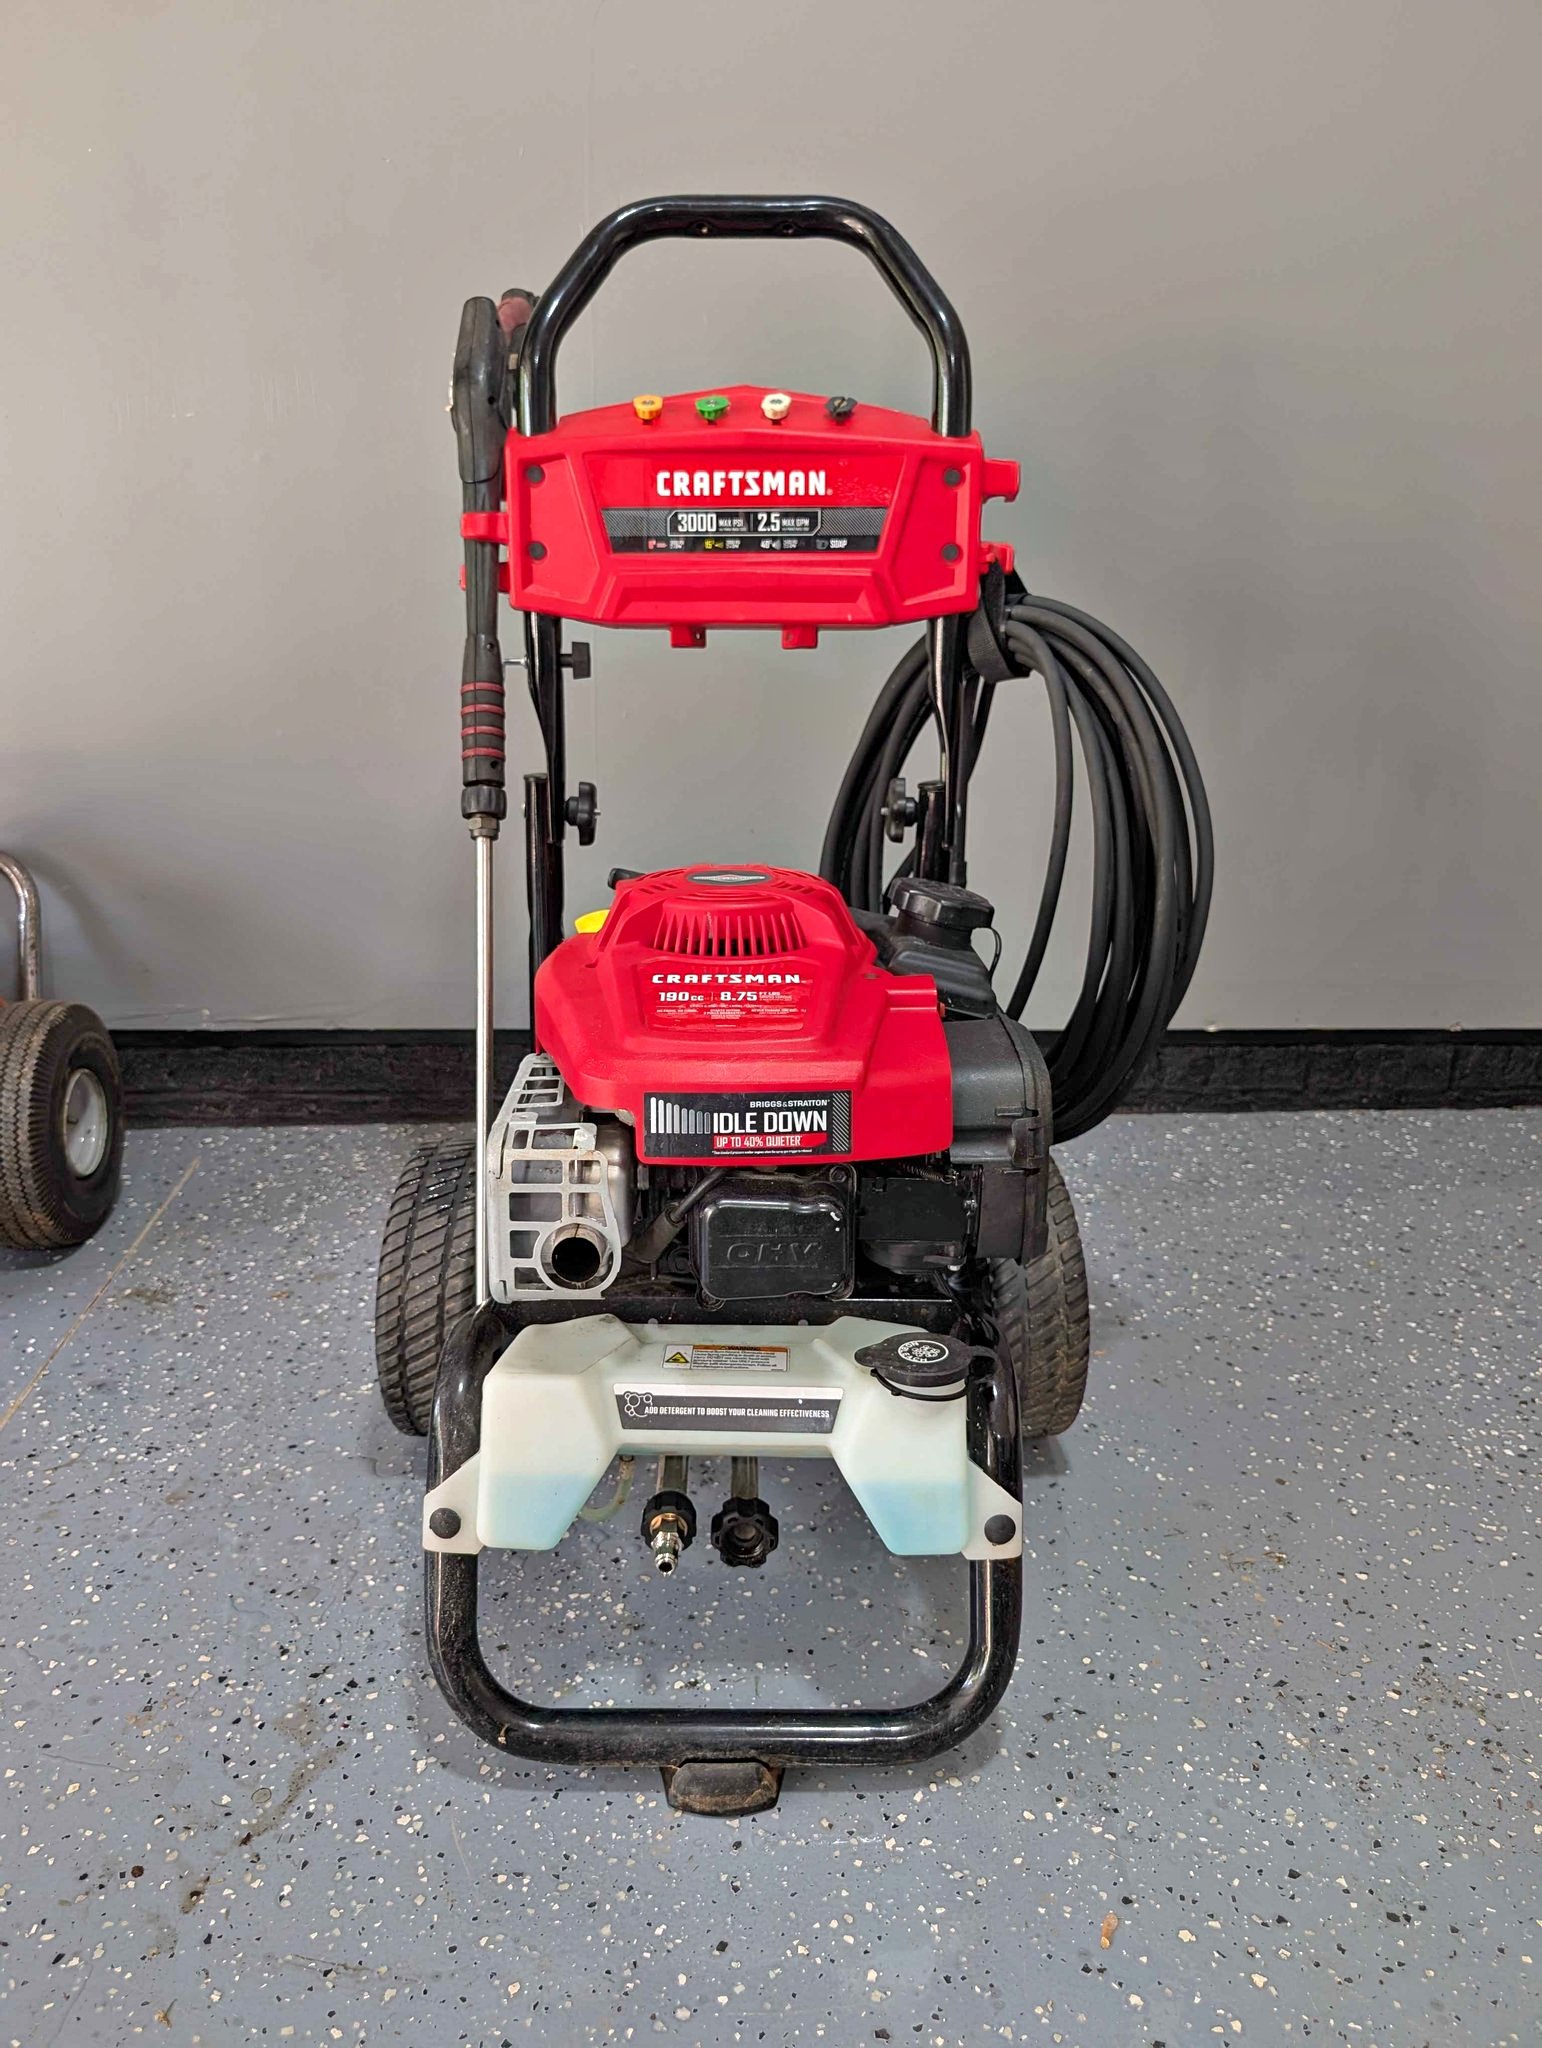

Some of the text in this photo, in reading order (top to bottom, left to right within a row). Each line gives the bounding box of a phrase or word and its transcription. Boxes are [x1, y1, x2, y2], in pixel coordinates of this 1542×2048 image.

[656, 471, 826, 496] CRAFTSMAN
[678, 513, 717, 532] 3000
[758, 513, 780, 532] 2.5
[652, 974, 800, 984] CRAFTSMAN
[720, 991, 758, 1002] 8.75
[713, 1110, 828, 1134] IDLE DOWN
[716, 1137, 728, 1147] UP
[731, 1136, 742, 1147] TO
[744, 1136, 763, 1147] 40%
[644, 1406, 830, 1418] ADD DETERGENT TO BOOST YOUR CLEANING EFFECTIVENESS
